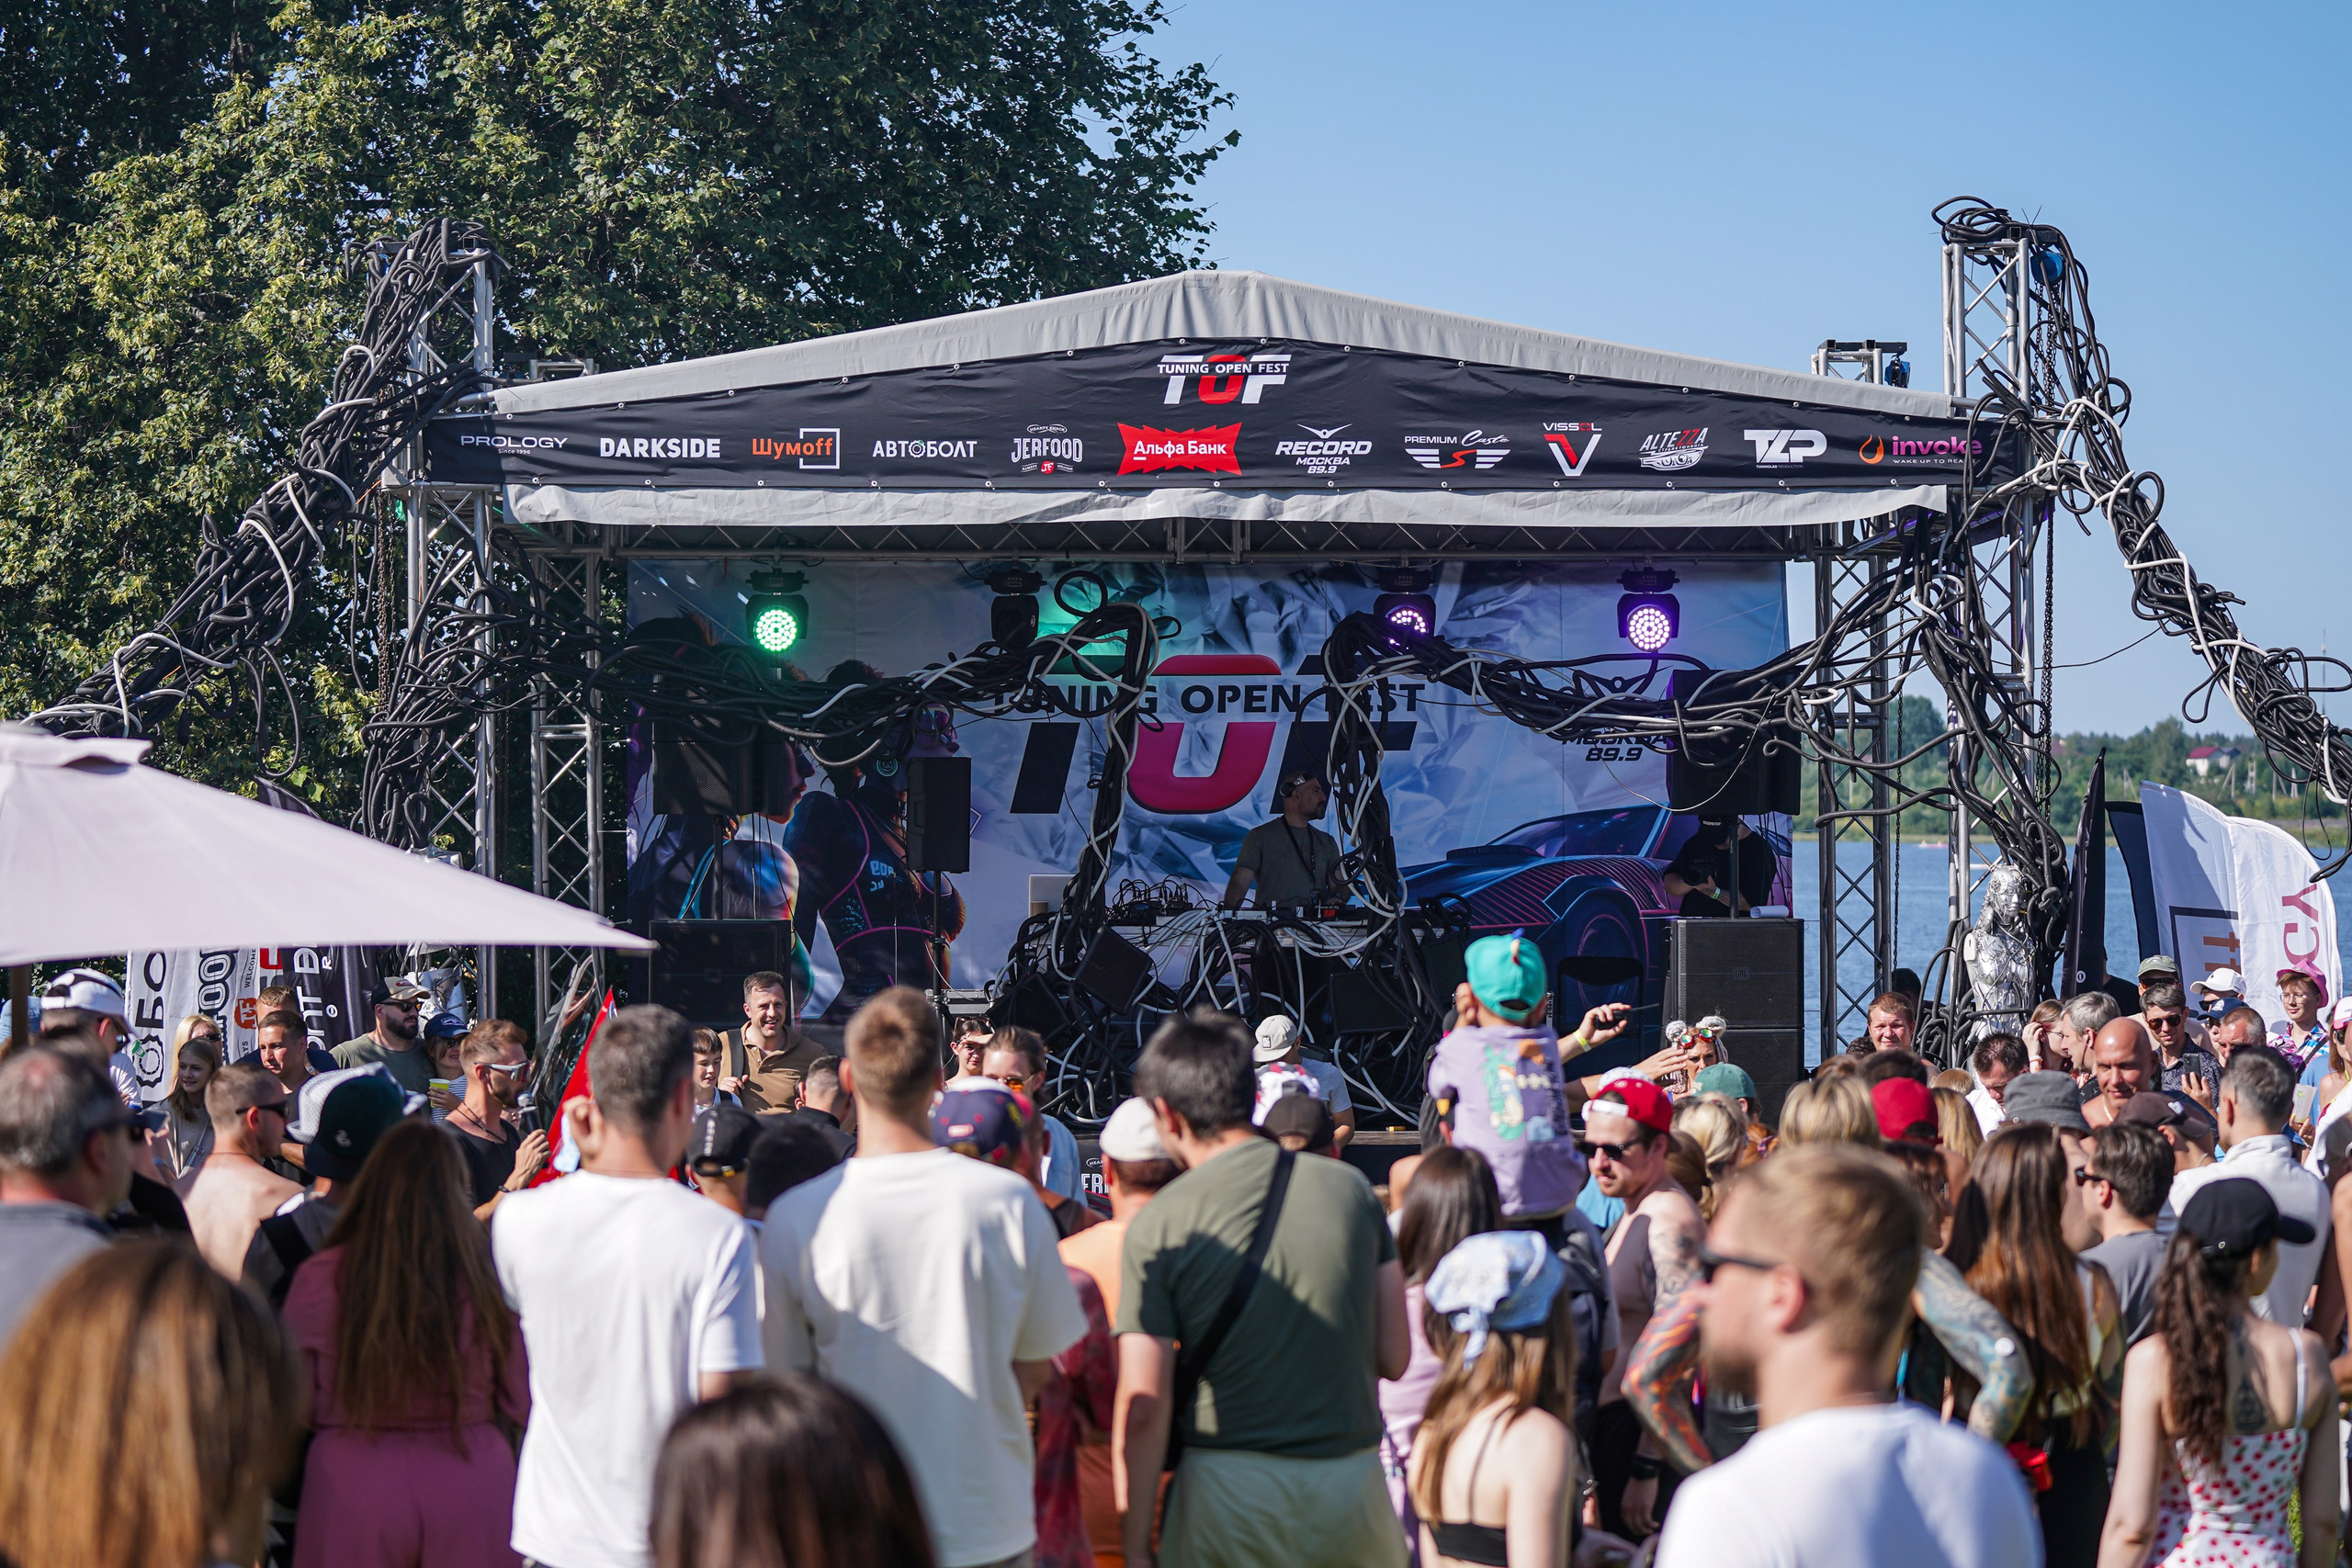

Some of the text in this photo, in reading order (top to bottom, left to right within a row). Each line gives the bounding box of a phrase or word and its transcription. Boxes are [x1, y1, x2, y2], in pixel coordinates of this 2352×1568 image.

[1157, 363, 1289, 374] TUNING OPEN FEST
[1543, 423, 1602, 432] VISSOL
[460, 435, 568, 448] PROLOGY
[1405, 435, 1457, 444] PREMIUM
[1639, 427, 1709, 451] ALTEZZA
[1892, 435, 1983, 456] invoke
[600, 437, 720, 458] DARKSIDE
[752, 437, 833, 459] Шумоff
[1011, 437, 1083, 463] JERFOOD
[1133, 440, 1227, 458] Альфа Банк
[1275, 441, 1373, 456] RECORD
[1041, 462, 1055, 472] JF
[1295, 457, 1351, 466] МОСКВА
[1307, 466, 1337, 474] 89.9
[991, 685, 1158, 714] NING
[1181, 684, 1301, 714] OPEN
[1585, 747, 1644, 761] 89.9
[244, 948, 256, 988] WELCOME
